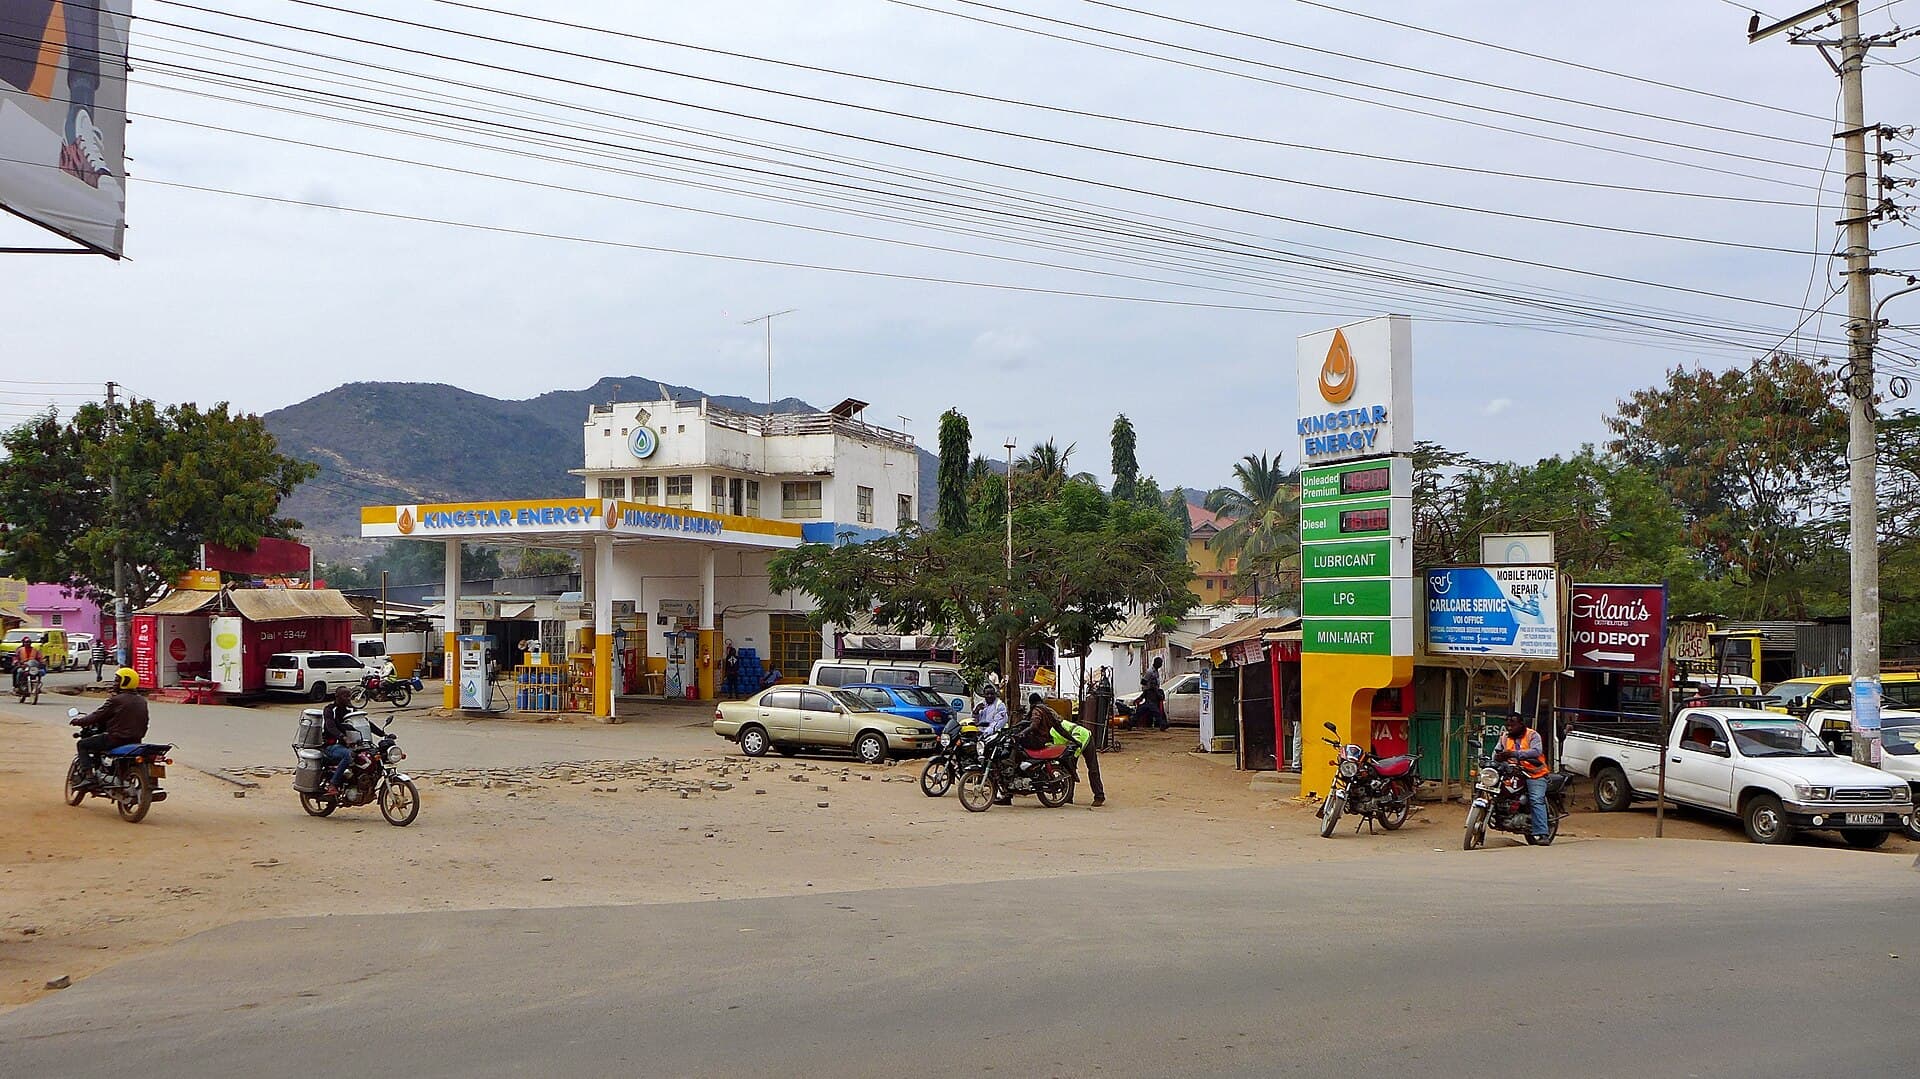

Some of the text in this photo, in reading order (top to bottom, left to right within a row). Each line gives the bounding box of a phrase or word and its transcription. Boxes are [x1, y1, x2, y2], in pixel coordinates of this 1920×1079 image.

[1297, 405, 1387, 435] KINGSTAR
[1305, 428, 1378, 456] ENERGY
[1303, 473, 1339, 486] Unleaded
[1303, 488, 1337, 499] Premium
[424, 506, 595, 528] KINGSTAR ENERGY
[624, 509, 724, 535] KINGSTAR ENERGY
[1303, 519, 1327, 530] Diesel
[1314, 553, 1376, 568] LUBRICANT
[1497, 569, 1555, 581] MOBILE PHONE
[1511, 584, 1539, 595] REPAIR
[1333, 592, 1355, 605] LPG
[1430, 598, 1506, 613] CARLCARE SERVICE
[1572, 593, 1651, 621] Gilani's
[1452, 615, 1484, 624] VOI OFFICE
[1317, 631, 1375, 645] MINI-MART
[1572, 631, 1595, 644] VOI
[1598, 632, 1650, 647] DEPOT
